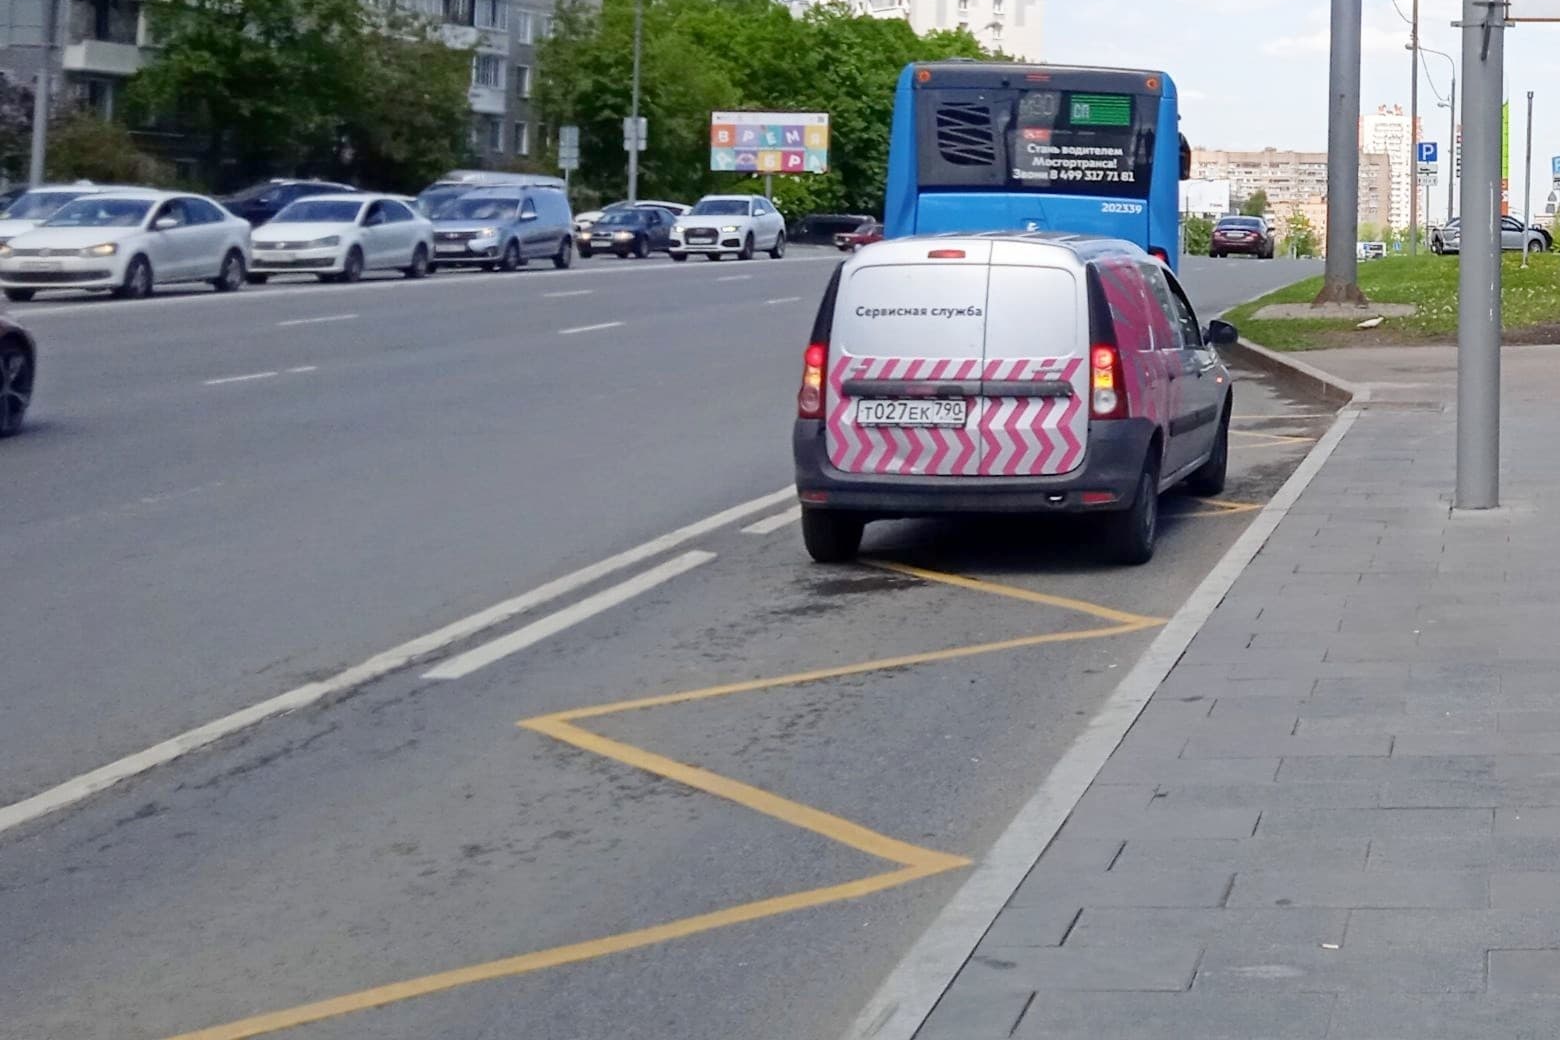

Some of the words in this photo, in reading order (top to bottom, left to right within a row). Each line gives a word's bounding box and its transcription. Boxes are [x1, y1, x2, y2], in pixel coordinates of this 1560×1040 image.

[1027, 143, 1060, 154] Стань
[1061, 146, 1124, 156] водителем
[1422, 144, 1434, 160] P
[1032, 157, 1118, 170] Мосгортранса!
[1050, 169, 1058, 180] 8
[1059, 170, 1083, 180] 499
[1084, 171, 1104, 181] 317
[1106, 171, 1119, 181] 71
[1121, 171, 1135, 182] 81
[1101, 203, 1142, 214] 202339
[855, 306, 928, 319] Сервисная
[931, 305, 982, 319] служба
[864, 403, 931, 421] Т027ЕК
[934, 402, 962, 416] 790
